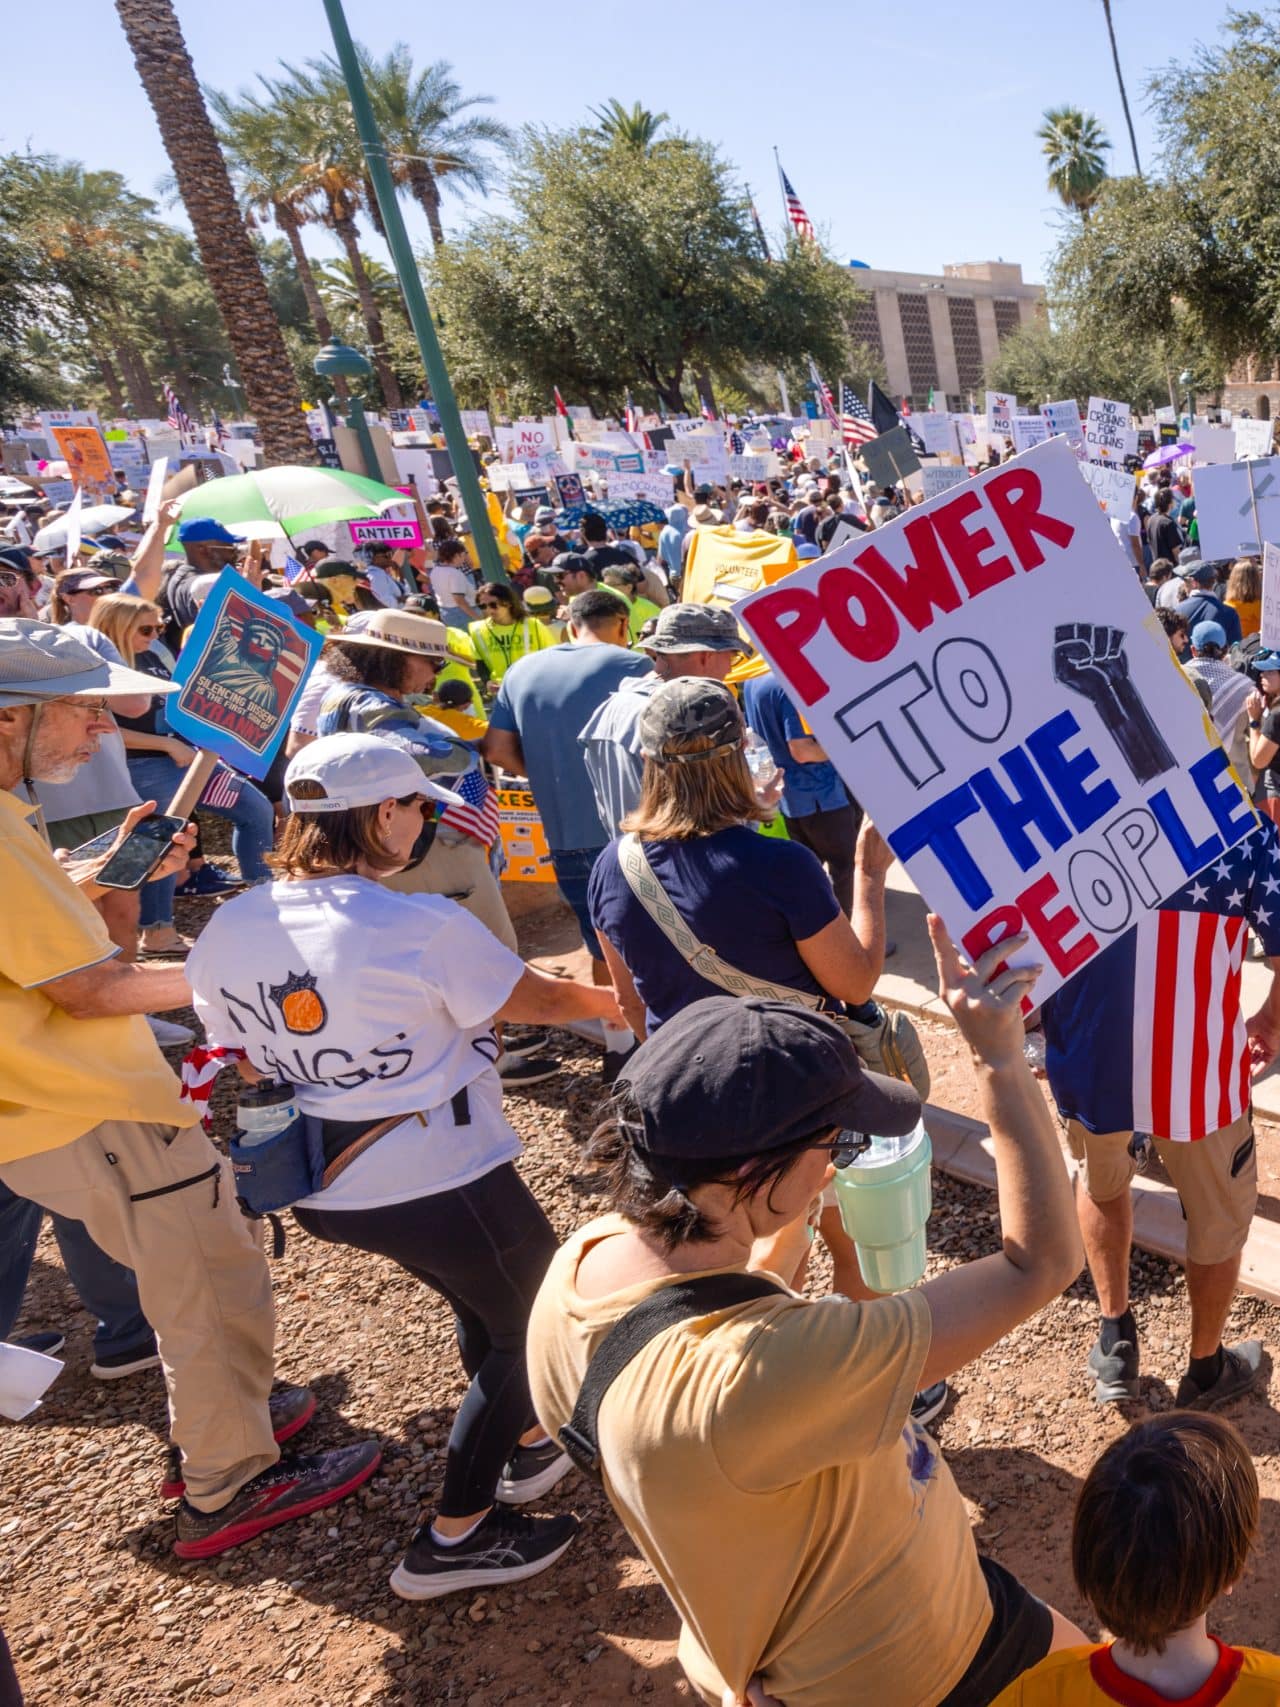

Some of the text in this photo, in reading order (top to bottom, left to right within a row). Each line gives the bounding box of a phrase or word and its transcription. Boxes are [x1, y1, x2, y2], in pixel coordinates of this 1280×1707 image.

[1103, 402, 1116, 412] NO
[993, 420, 1010, 430] NO
[1089, 410, 1127, 427] CROWNS
[521, 431, 545, 444] NO
[1097, 423, 1116, 436] FOR
[1087, 432, 1125, 450] CLOWNS
[357, 527, 414, 539] ANTIFA
[742, 468, 1075, 706] POWER
[198, 676, 278, 726] SILENCING DISSENT
[207, 691, 223, 704] THE
[188, 691, 270, 743] TYRANNY
[835, 636, 1012, 789] TO
[888, 710, 1122, 911] THE
[961, 747, 1261, 1019] PEOPLE
